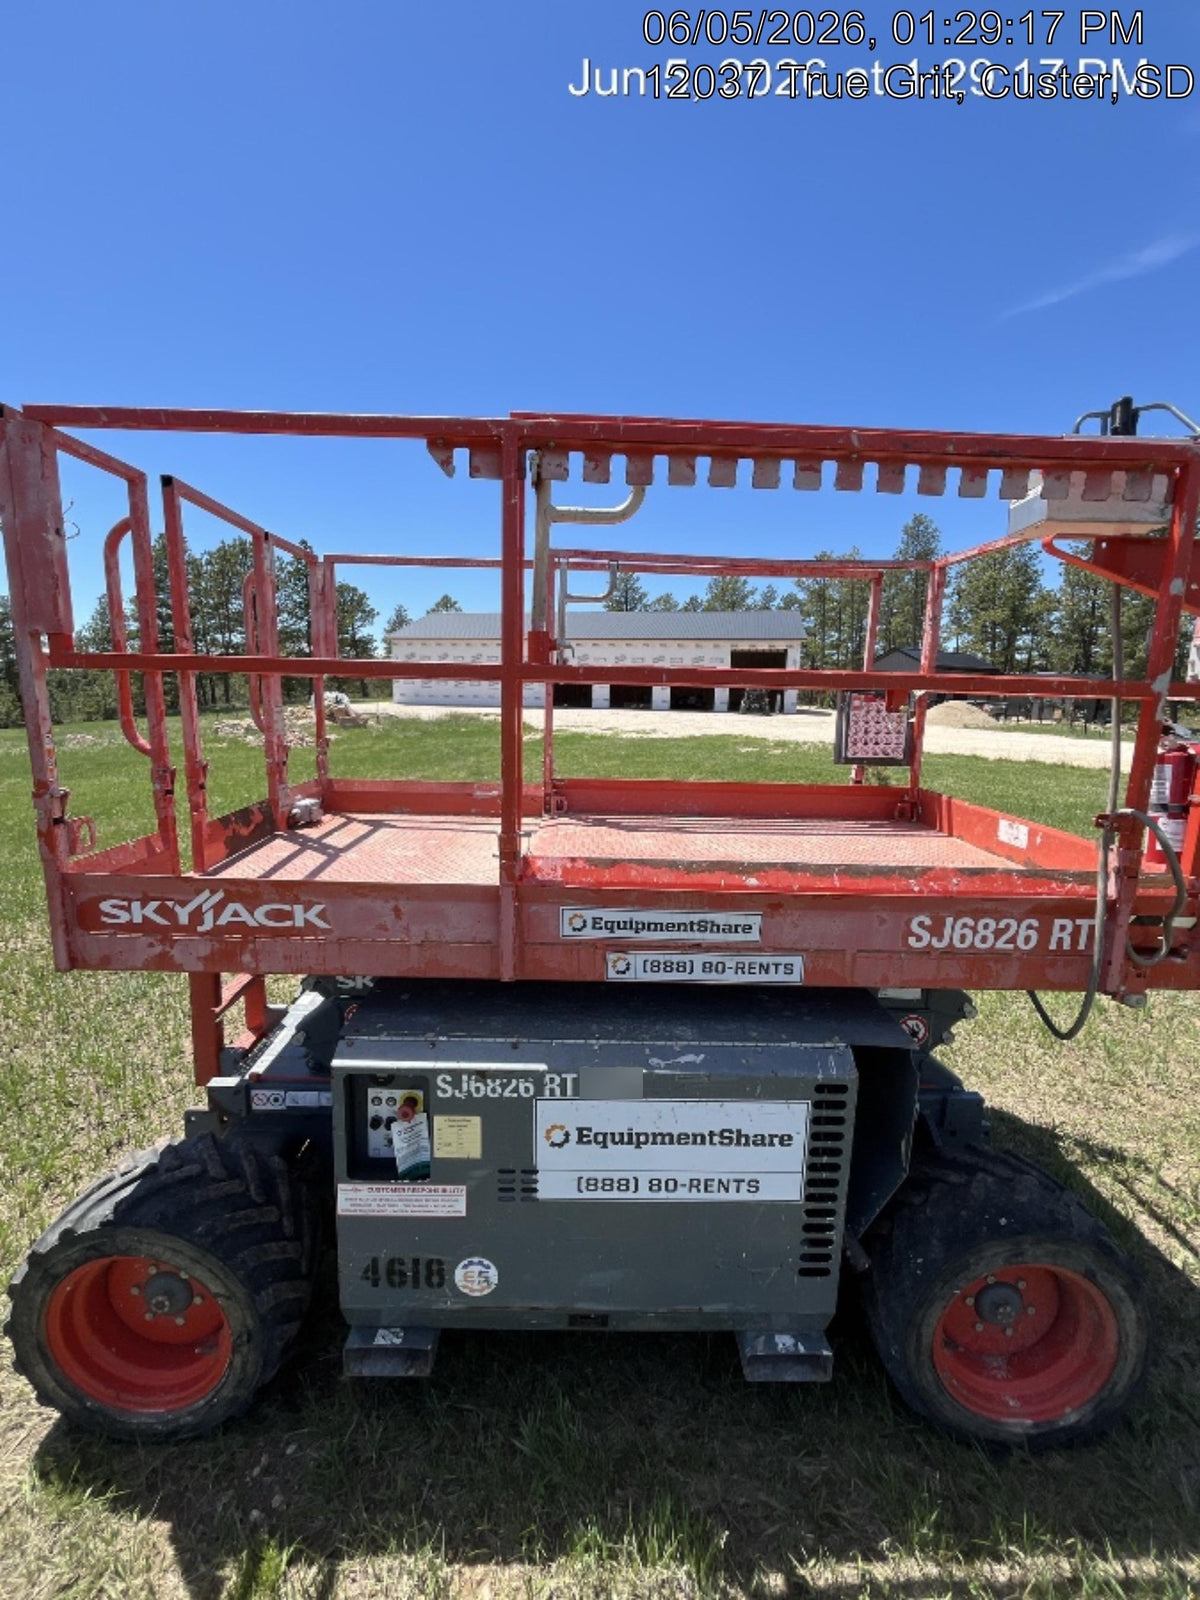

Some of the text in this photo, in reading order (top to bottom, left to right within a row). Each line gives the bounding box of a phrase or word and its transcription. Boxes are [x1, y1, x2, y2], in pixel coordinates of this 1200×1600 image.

[99, 888, 332, 932] SKYJACK
[591, 916, 753, 935] EquipmentShare
[908, 914, 1097, 951] SJ6826 RT
[643, 959, 794, 976] (888) 80-RENTS
[436, 1073, 578, 1099] SJ6826 RT
[575, 1126, 794, 1149] EquipmentShare
[577, 1176, 760, 1194] (888) 80-RENTS
